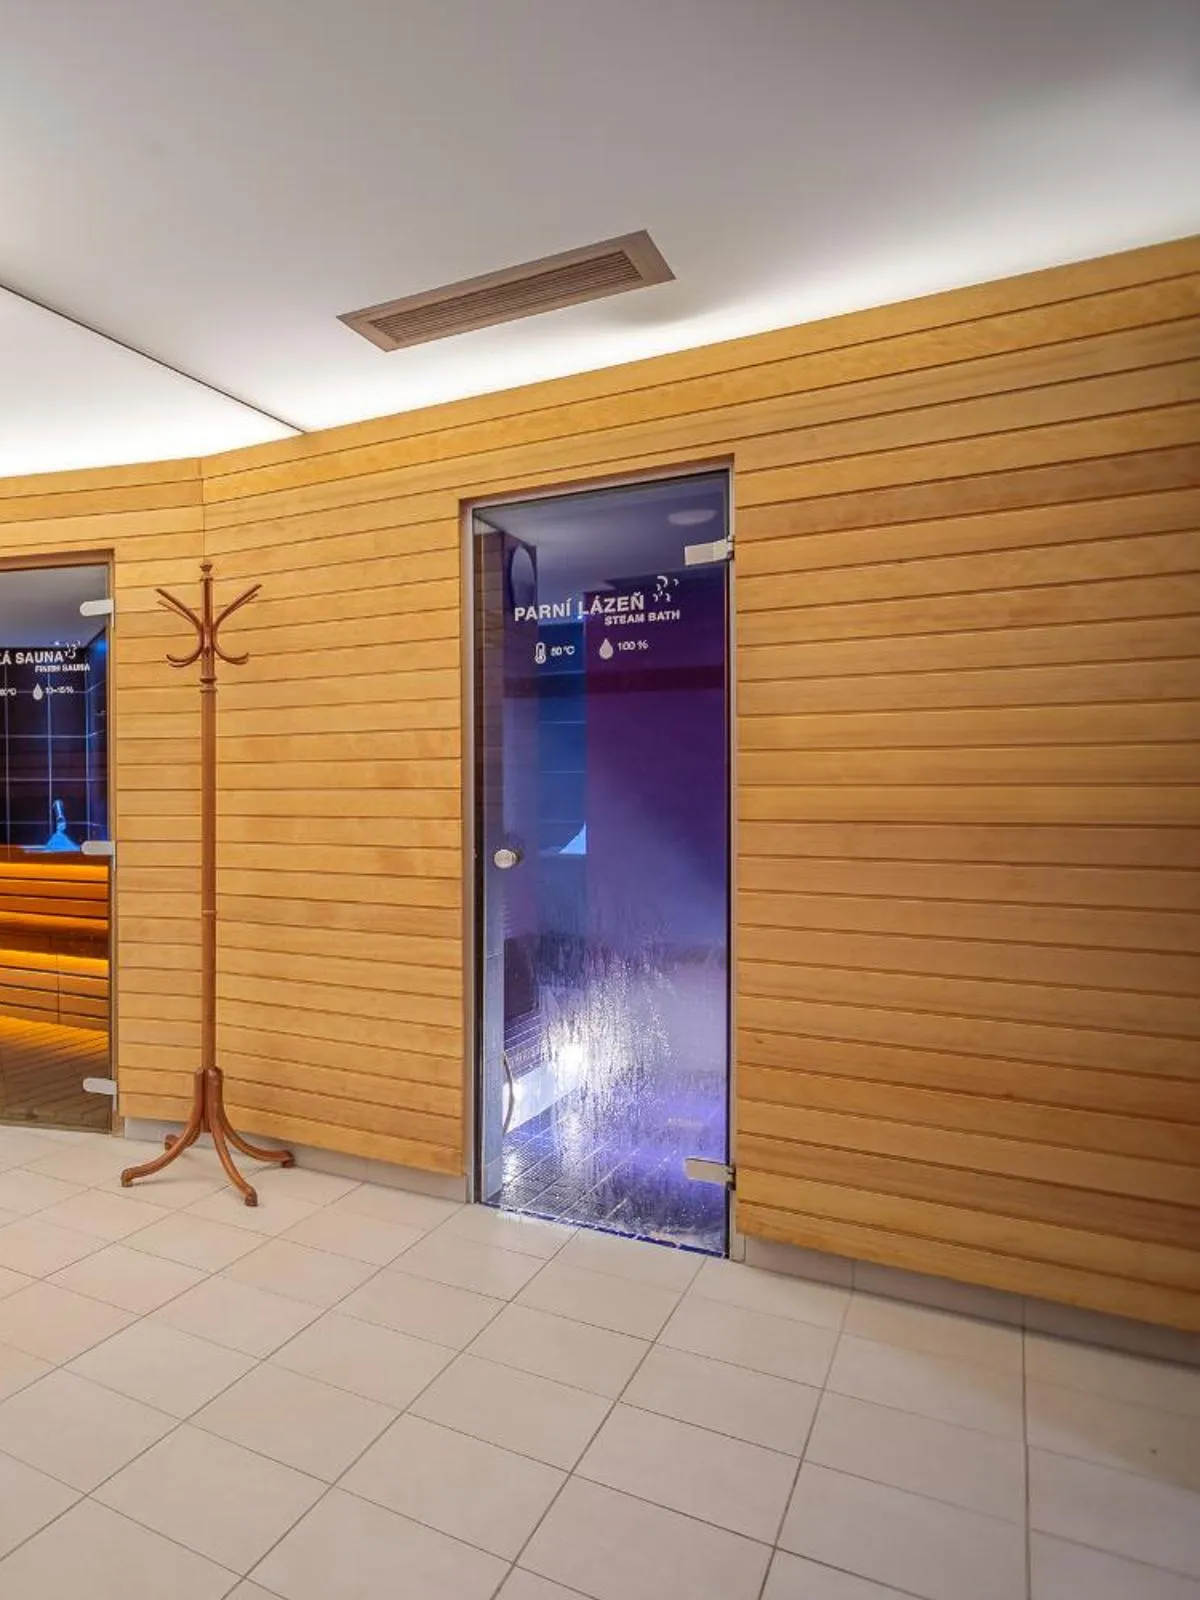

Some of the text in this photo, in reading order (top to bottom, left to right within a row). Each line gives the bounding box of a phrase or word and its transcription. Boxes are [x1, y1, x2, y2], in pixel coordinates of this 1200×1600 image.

[514, 592, 645, 622] PARNÍ LÁZEŇ
[604, 609, 681, 626] STEAM BATH
[15, 651, 65, 664] SAUNA
